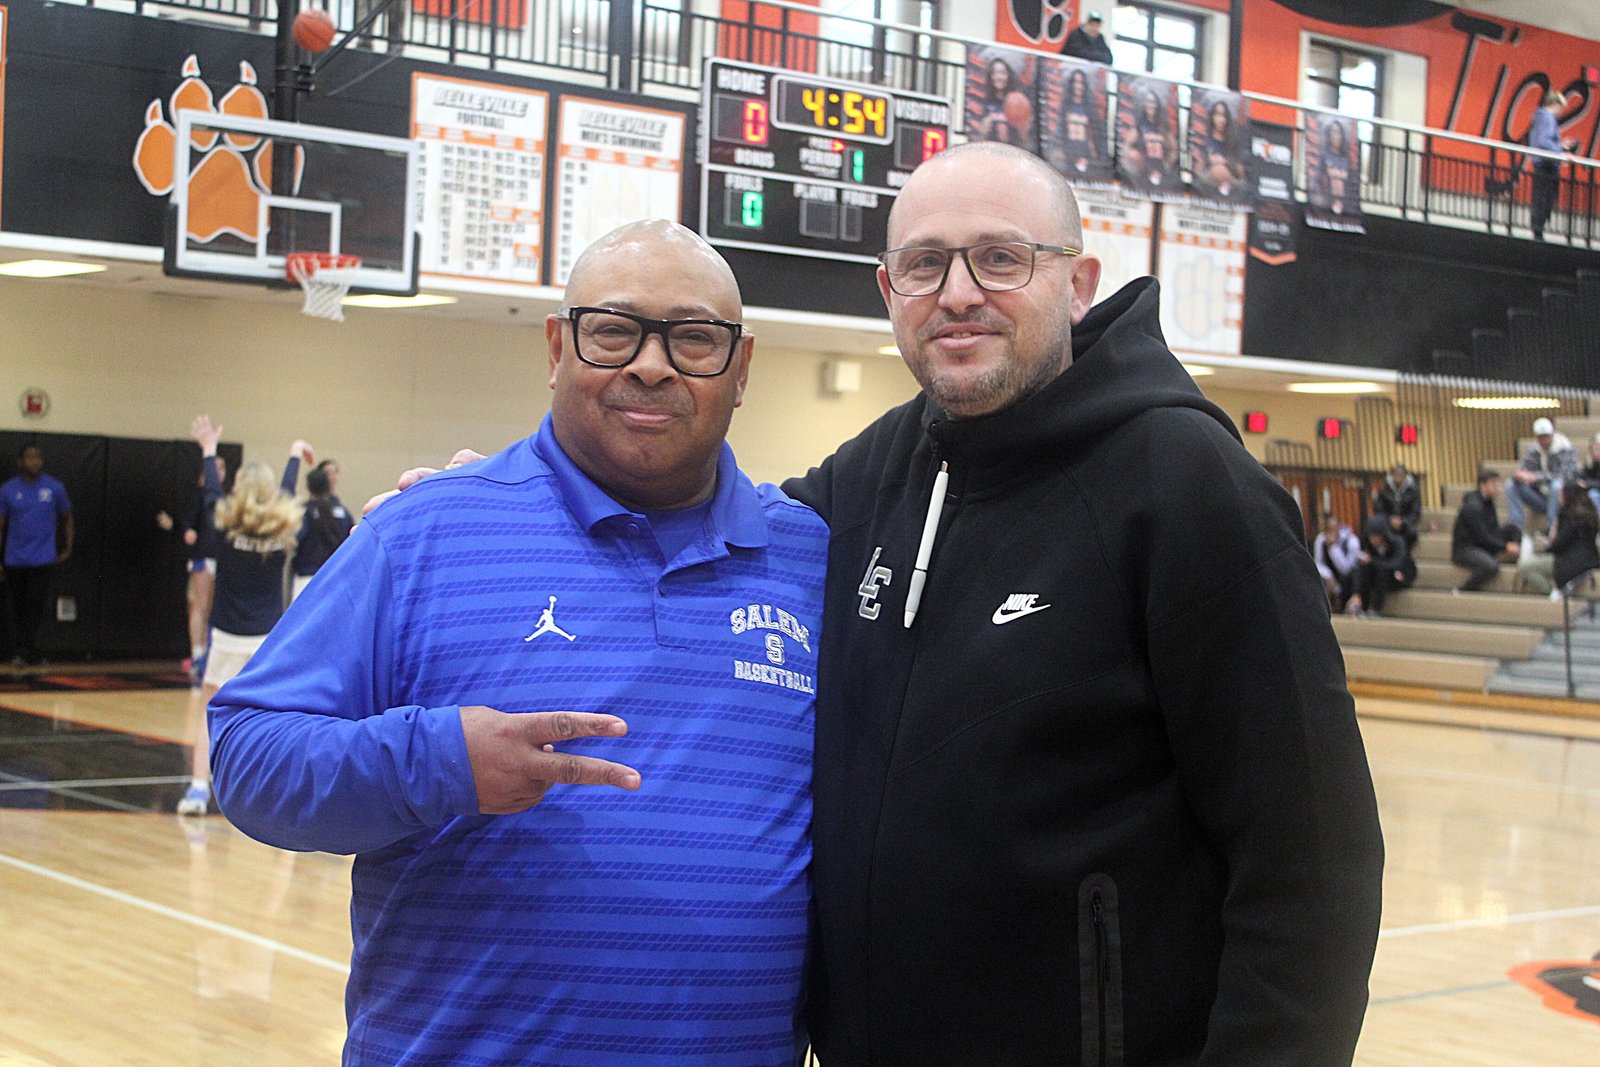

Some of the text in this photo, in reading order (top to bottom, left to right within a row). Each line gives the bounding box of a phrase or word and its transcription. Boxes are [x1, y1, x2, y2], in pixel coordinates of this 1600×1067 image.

[717, 68, 766, 95] HOME
[743, 98, 768, 145] 0
[802, 87, 886, 137] 4:54
[742, 191, 763, 227] 0
[1001, 593, 1040, 611] NIKE
[764, 632, 786, 666] S
[733, 659, 815, 695] BASKETBALL
